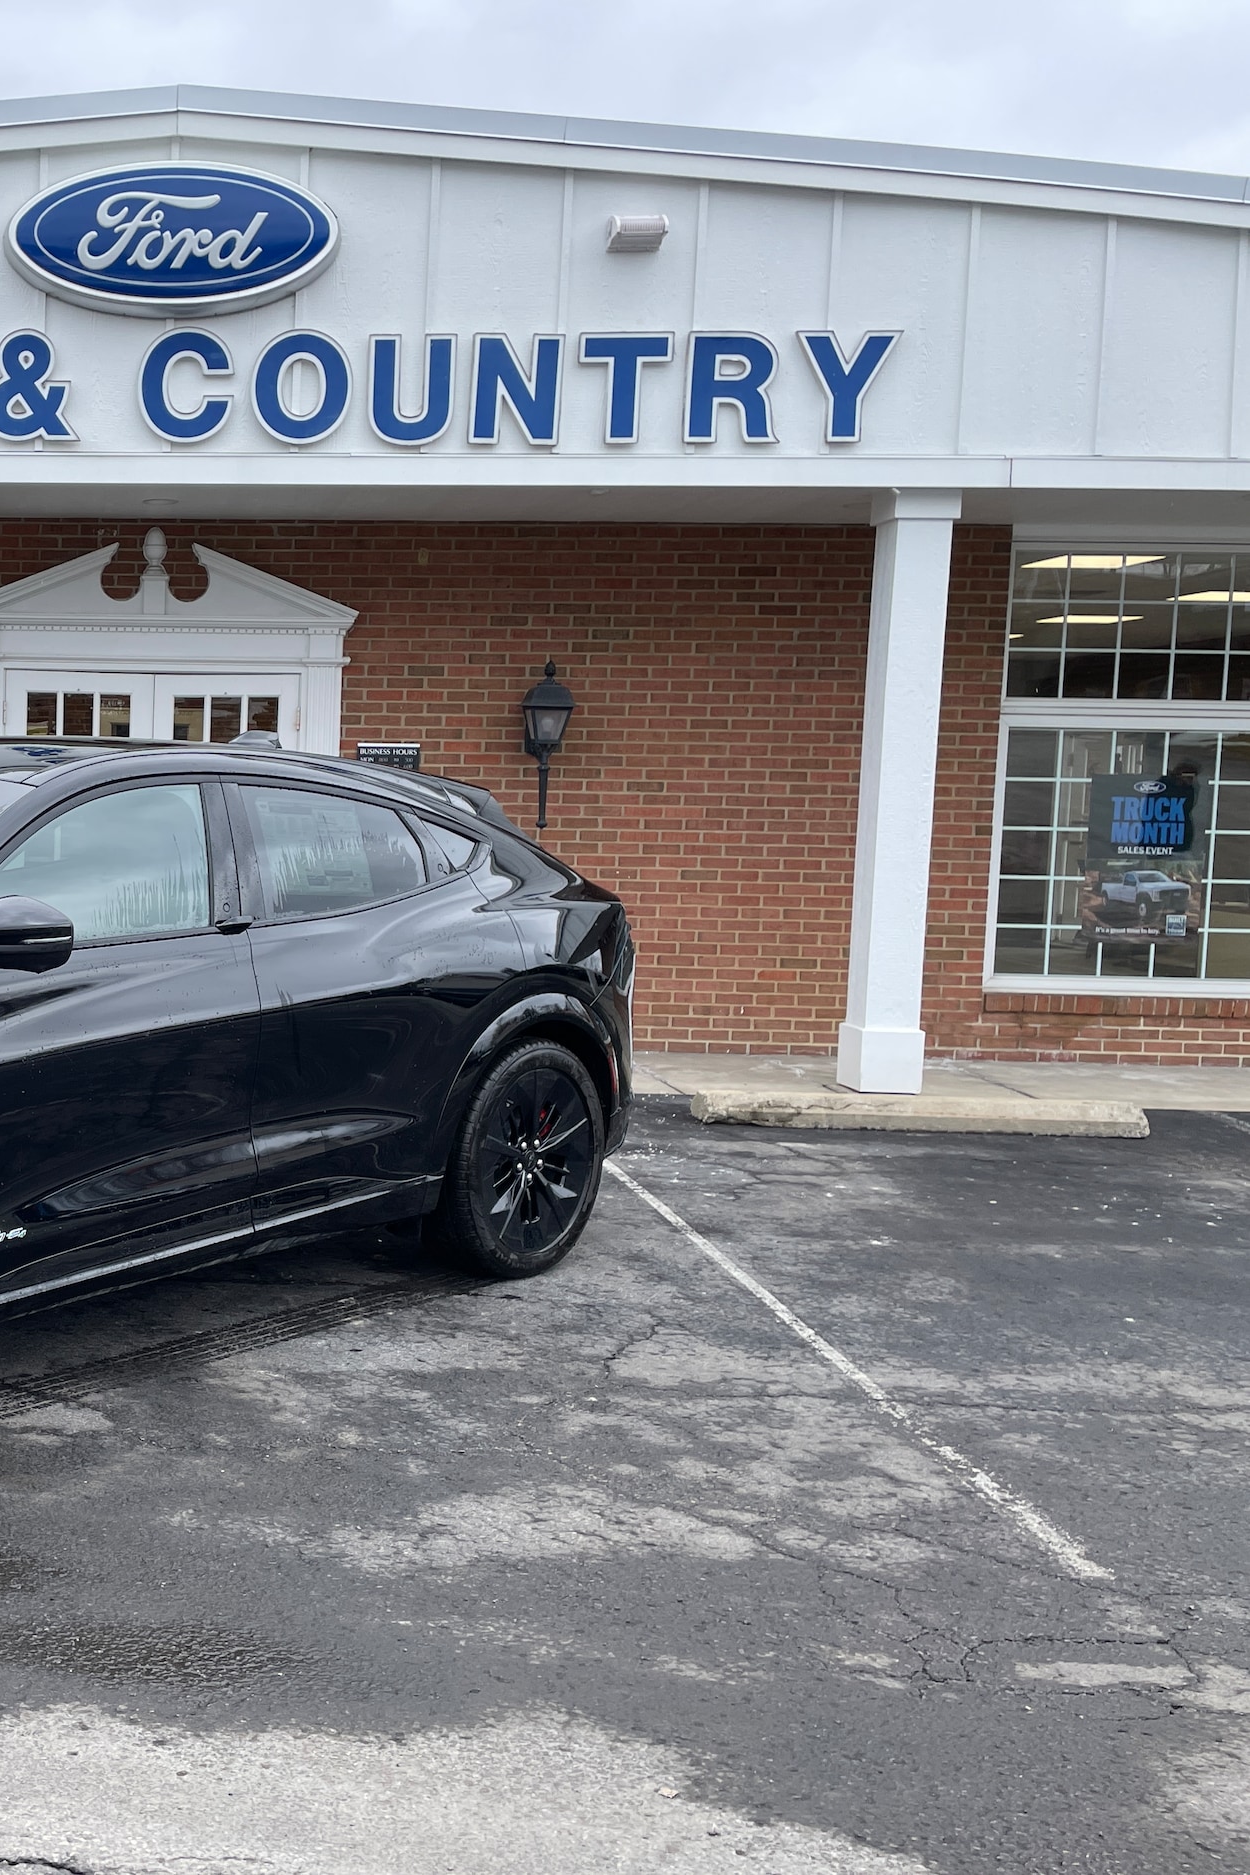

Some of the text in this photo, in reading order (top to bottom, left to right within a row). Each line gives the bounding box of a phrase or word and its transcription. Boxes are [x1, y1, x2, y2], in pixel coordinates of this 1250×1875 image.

[77, 191, 269, 270] Ford
[137, 325, 905, 446] COUNTRY
[393, 748, 418, 756] HOURS
[1111, 796, 1187, 822] TRUCK
[1110, 821, 1186, 845] MONTH
[1117, 846, 1174, 856] SALES EVENT
